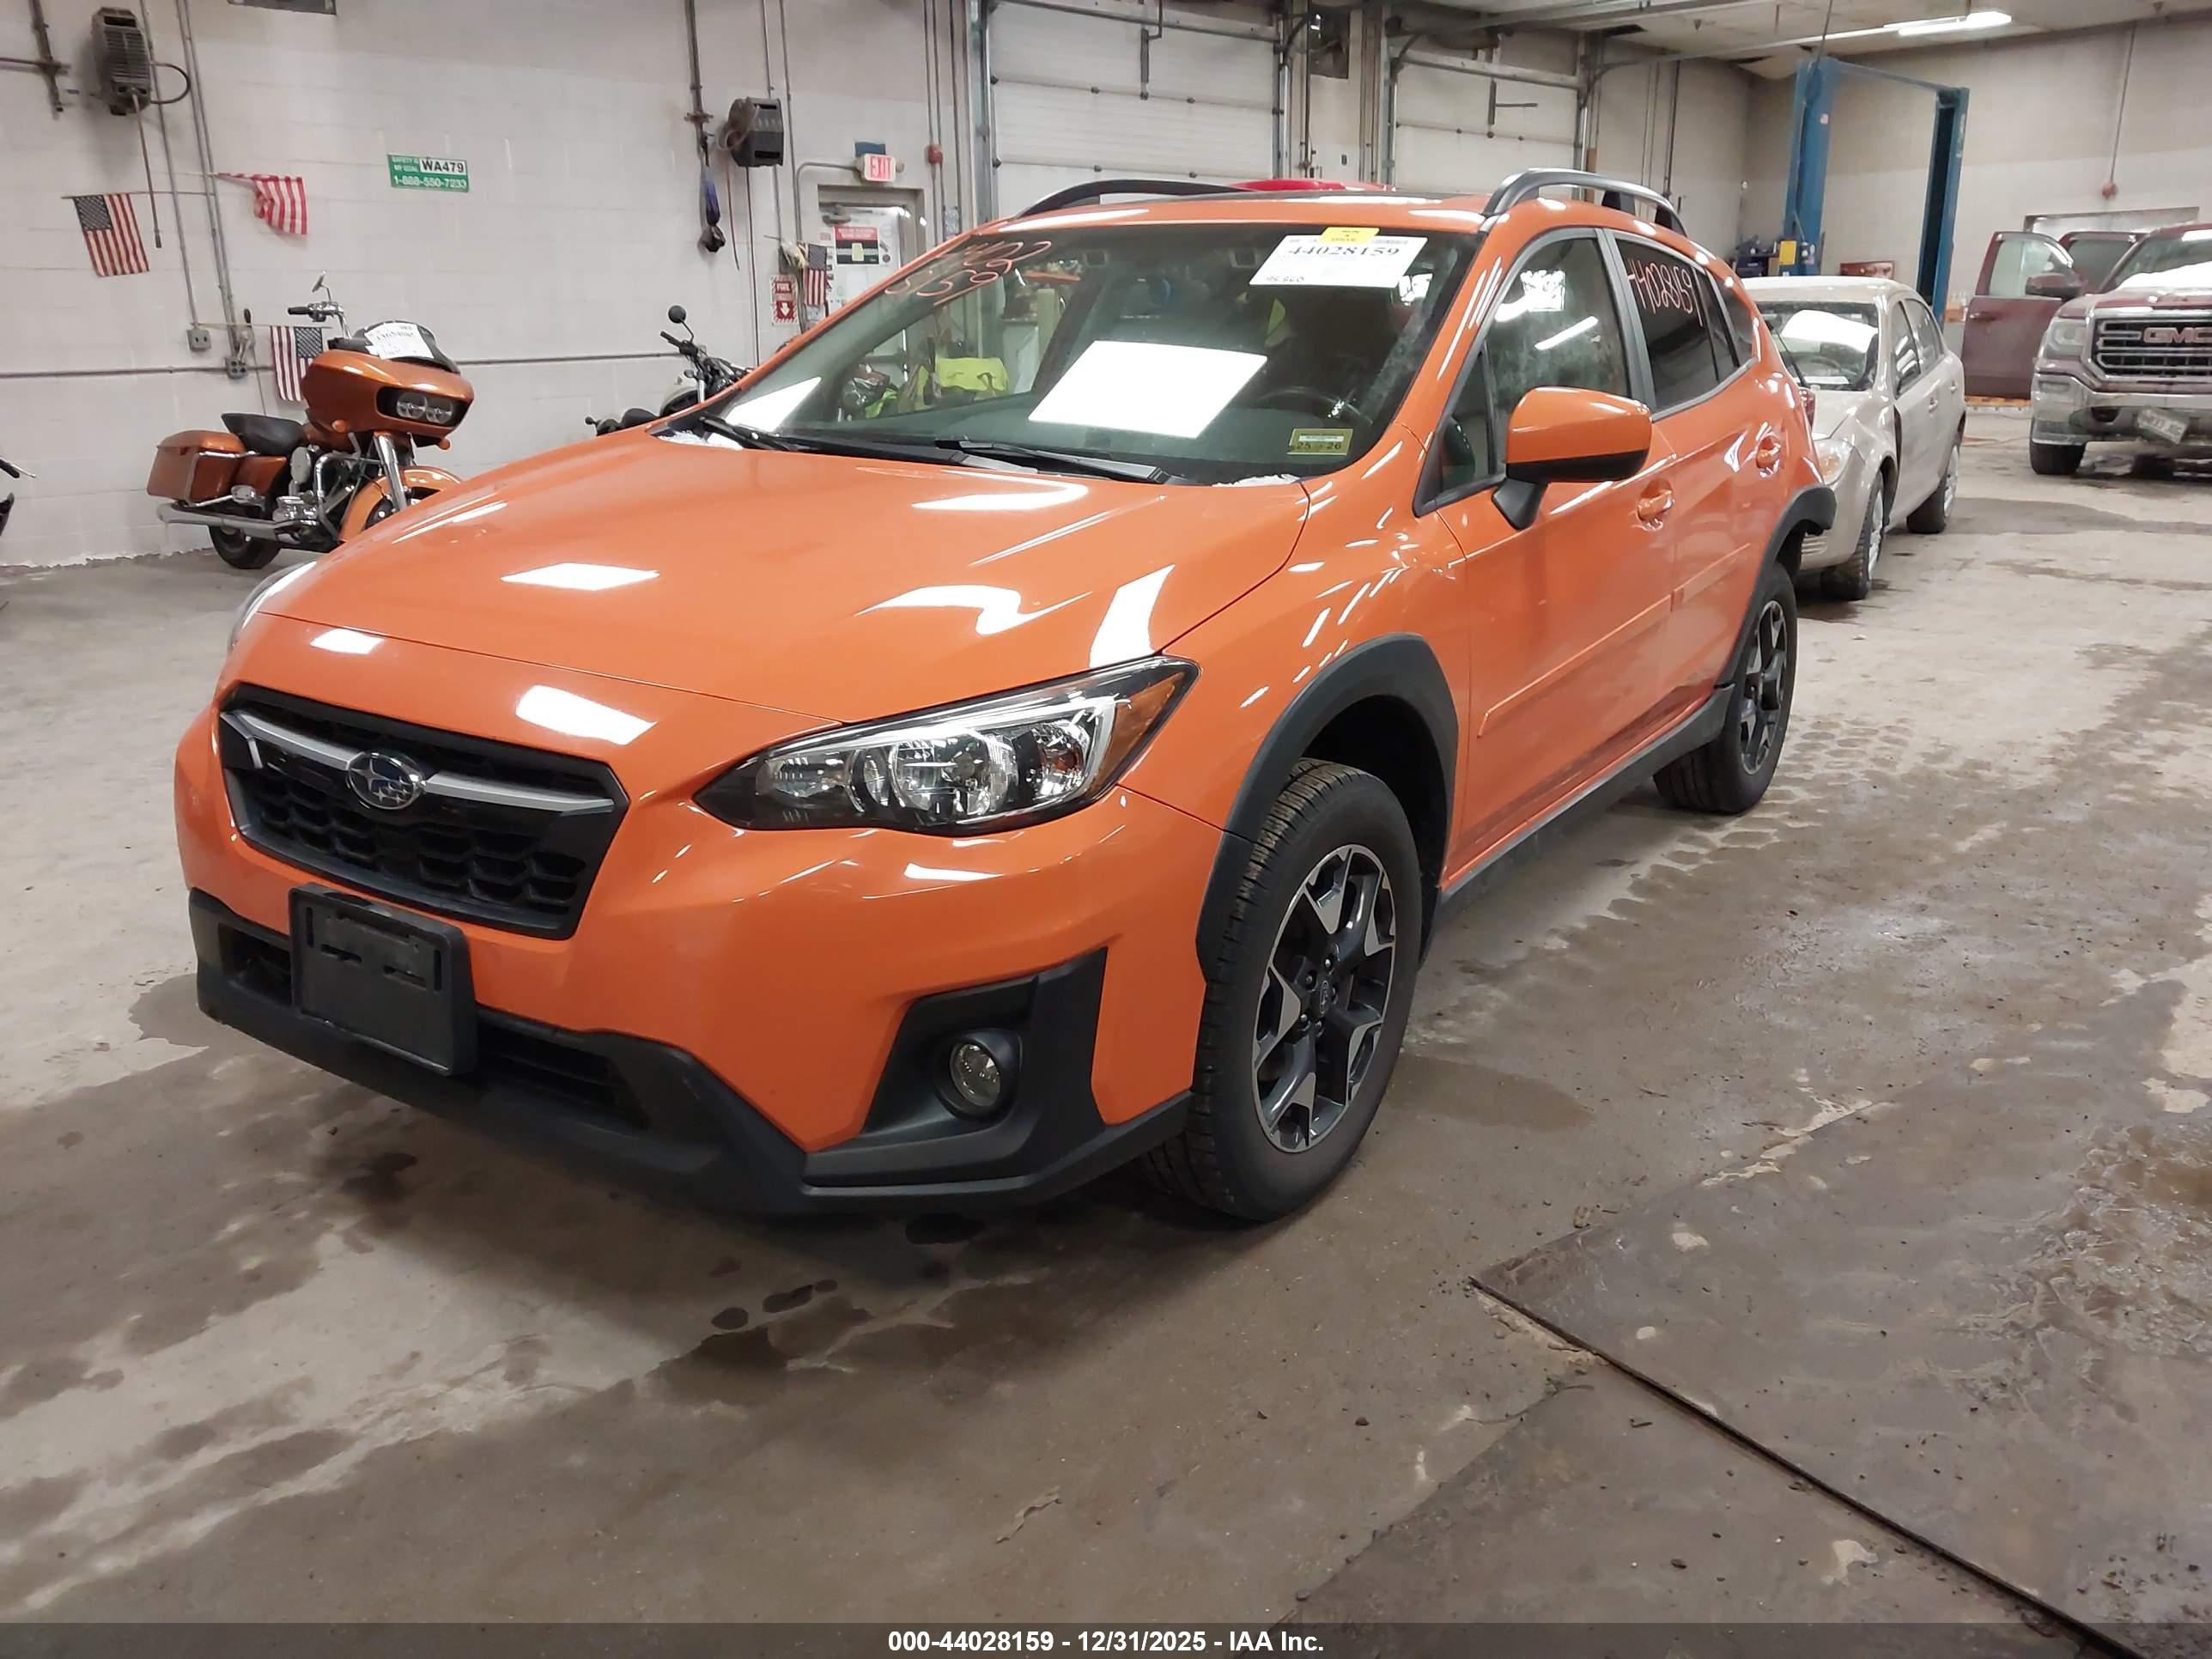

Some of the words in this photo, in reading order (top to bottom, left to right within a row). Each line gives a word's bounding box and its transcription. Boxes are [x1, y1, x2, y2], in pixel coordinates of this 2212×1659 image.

[422, 160, 465, 173] WA479
[869, 155, 891, 179] EXIT
[1287, 246, 1401, 256] 44028159
